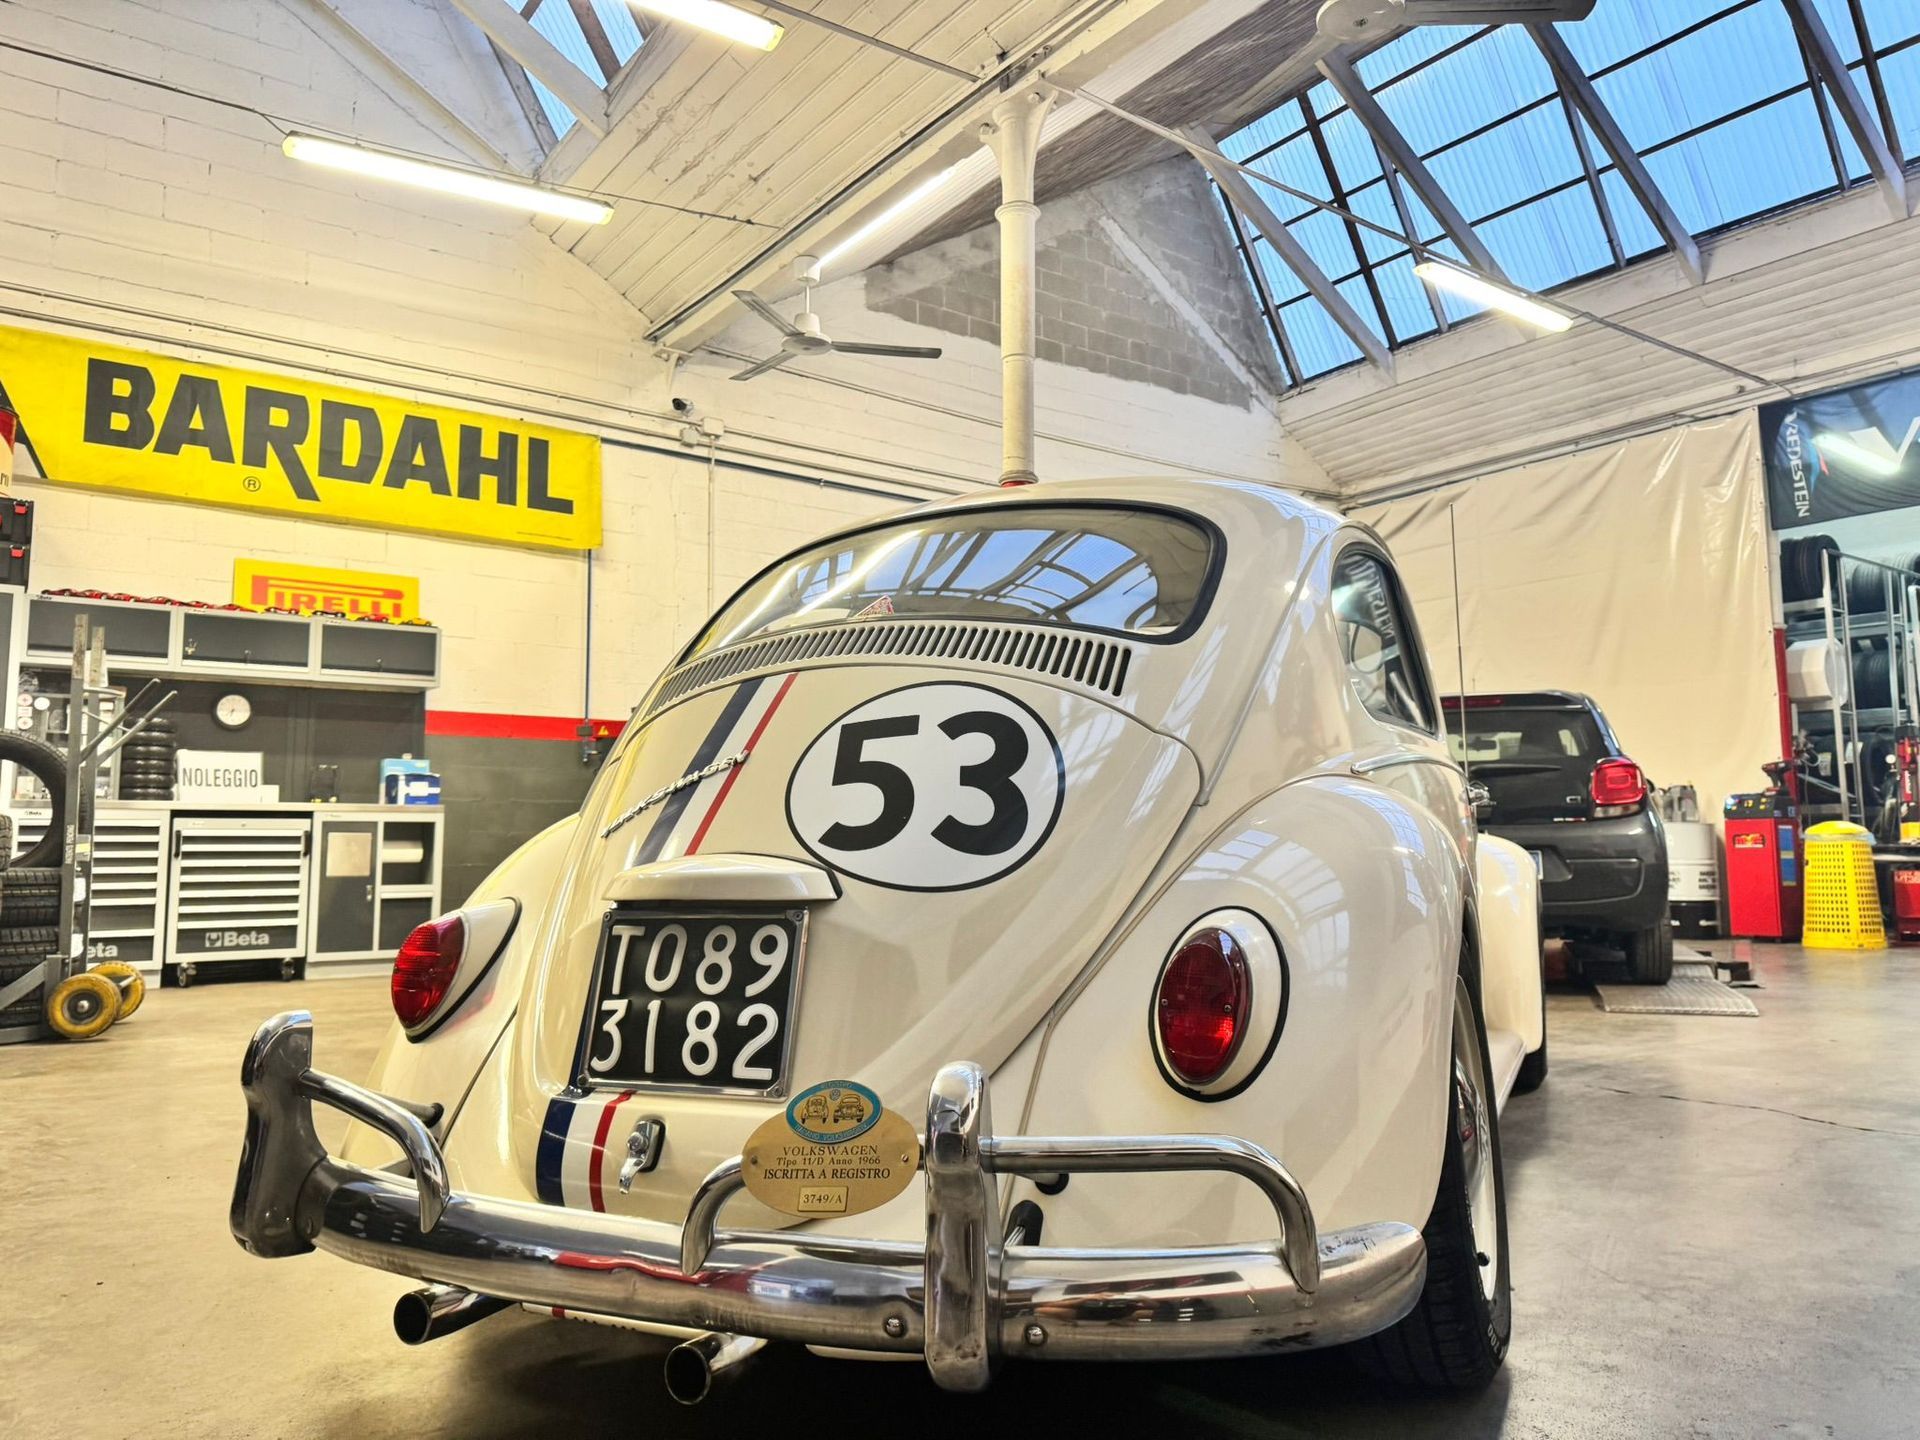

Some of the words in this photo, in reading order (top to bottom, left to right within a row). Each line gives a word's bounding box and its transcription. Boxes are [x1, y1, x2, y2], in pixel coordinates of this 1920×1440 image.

[83, 357, 574, 515] BARDAHL
[1783, 408, 1811, 518] VREDESTEIN
[251, 575, 404, 622] PIRELLI
[181, 766, 260, 788] NOLEGGIO
[817, 711, 1029, 856] 53
[223, 931, 271, 947] Beta
[86, 942, 119, 958] eta
[590, 999, 779, 1081] 3182
[783, 1145, 878, 1157] VOLKSWAGEN
[776, 1157, 797, 1168] Tipo
[828, 1158, 853, 1166] Anno
[858, 1156, 881, 1165] 1966
[763, 1168, 815, 1180] ISCRITTA
[818, 1169, 828, 1180] A
[831, 1167, 891, 1179] REGISTRO
[803, 1194, 843, 1204] 3749/A
